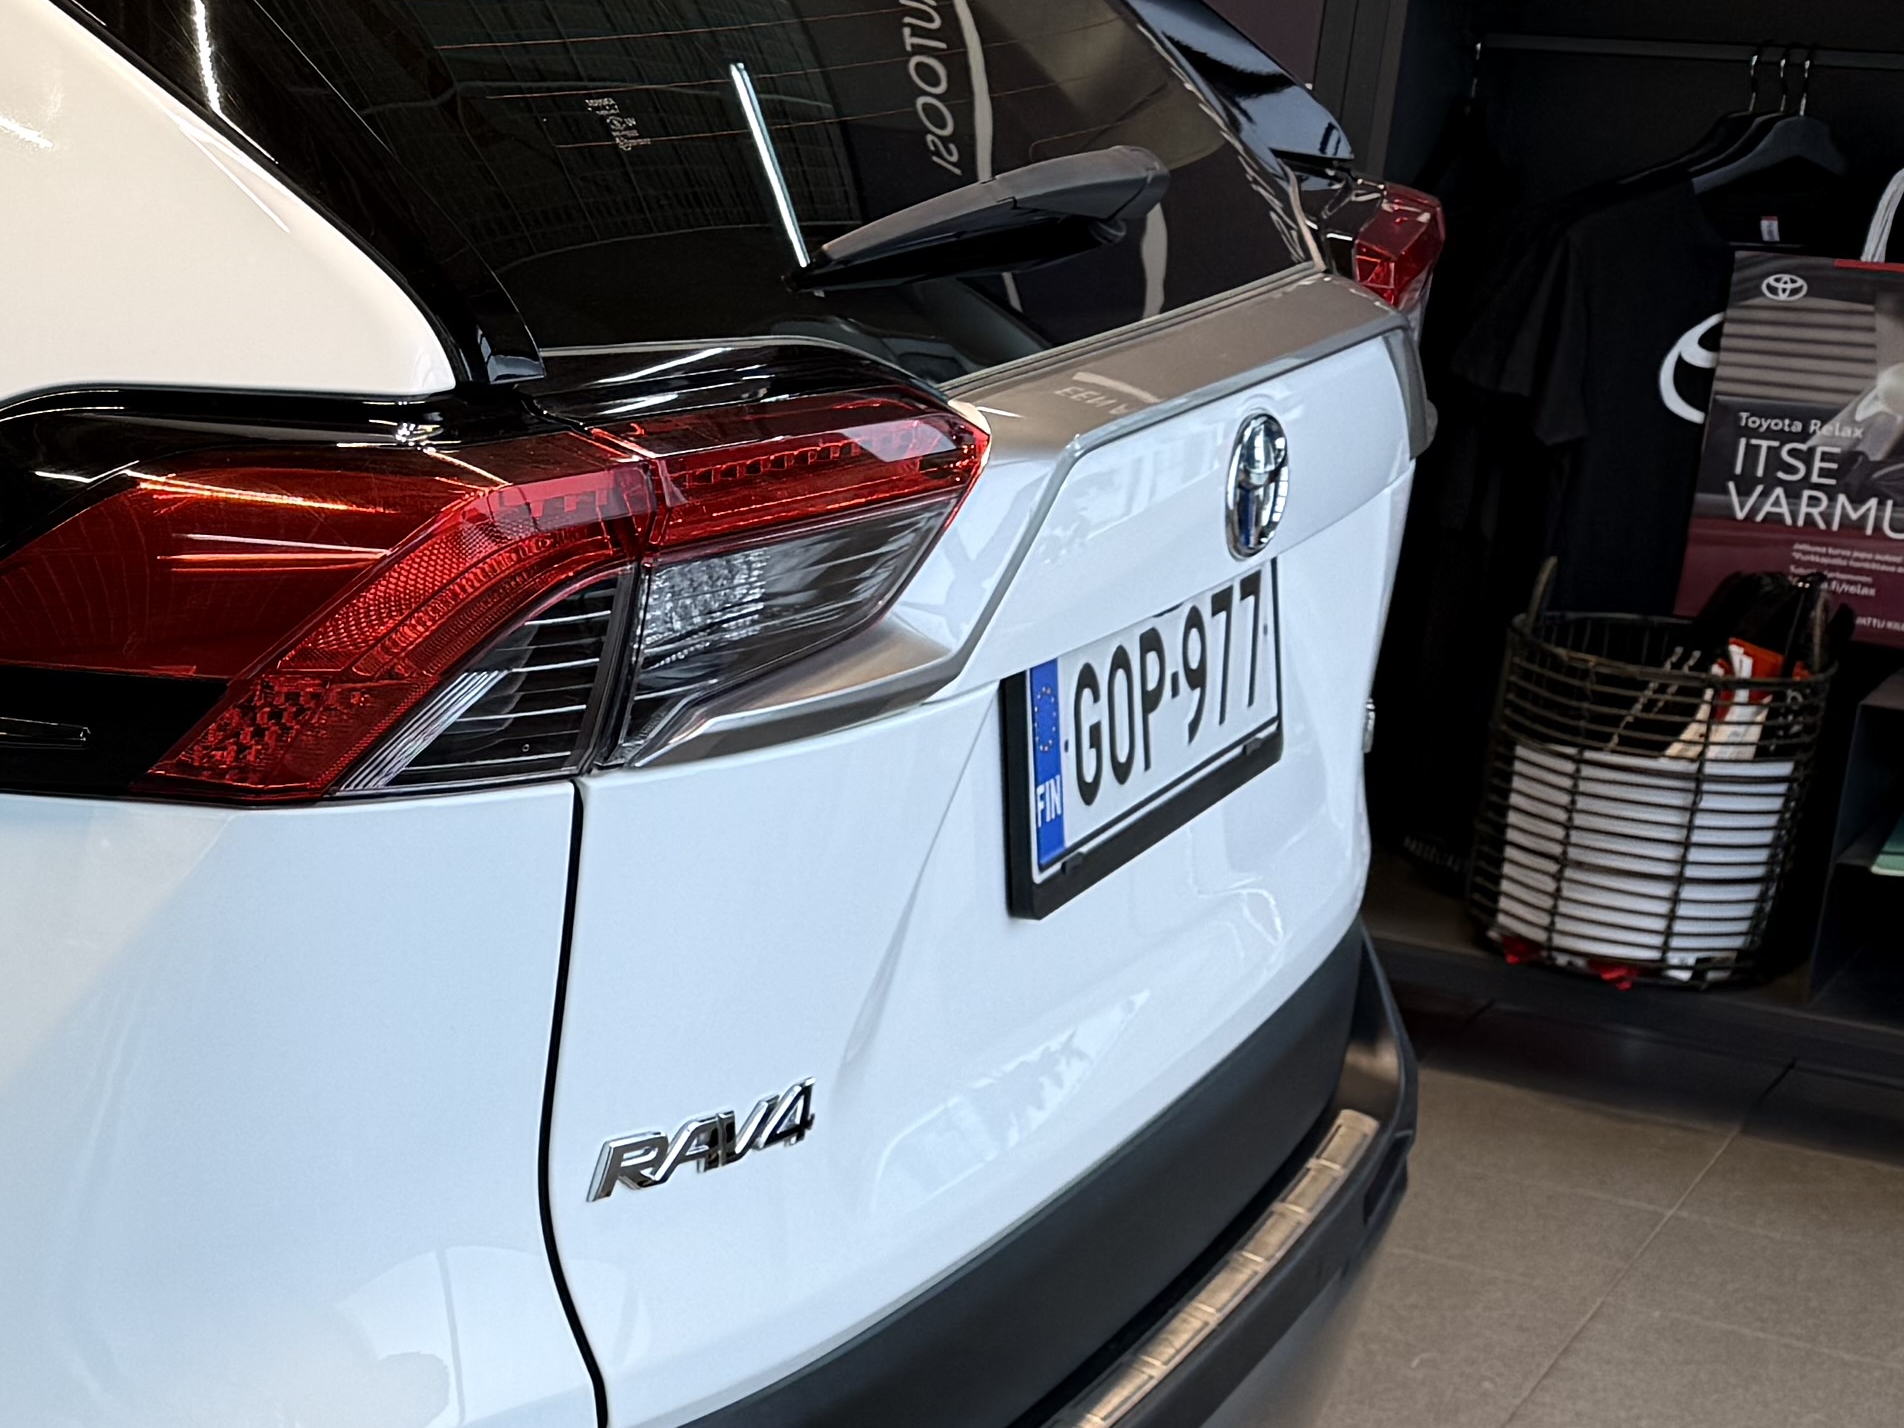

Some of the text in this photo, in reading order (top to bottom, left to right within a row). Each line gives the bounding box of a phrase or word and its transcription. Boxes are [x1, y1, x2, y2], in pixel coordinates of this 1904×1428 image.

[1738, 411, 1864, 439] Toyota Relax
[1734, 437, 1842, 486] ITSE
[1727, 480, 1904, 541] VARMU
[1073, 569, 1262, 807] GOP-977
[1036, 774, 1062, 828] FIN
[585, 1075, 817, 1203] RAV4
